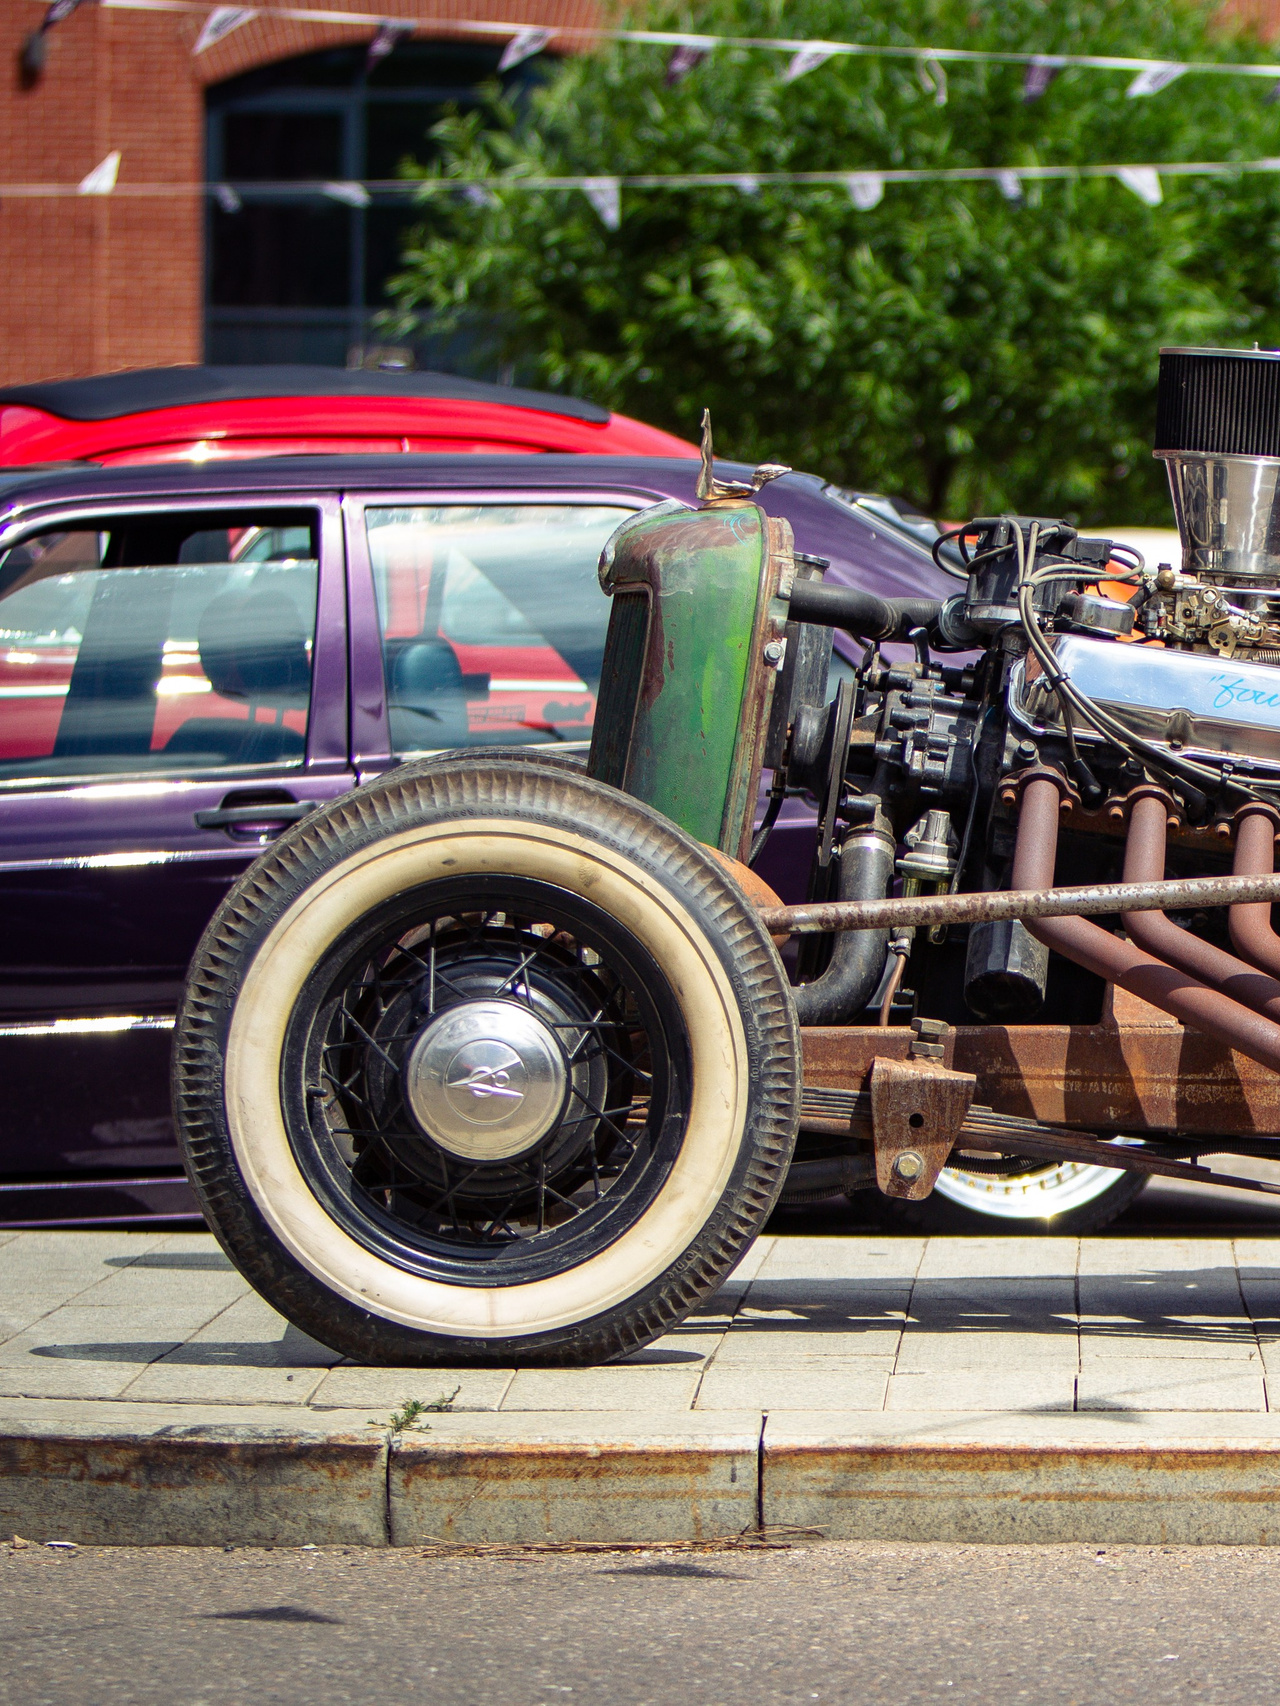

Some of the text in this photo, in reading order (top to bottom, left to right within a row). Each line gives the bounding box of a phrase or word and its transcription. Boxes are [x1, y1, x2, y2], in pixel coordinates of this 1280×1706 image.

[601, 833, 658, 874] POLYESTER
[730, 972, 759, 1083] DELUXE CHAMPION
[662, 1185, 739, 1283] Firestone
